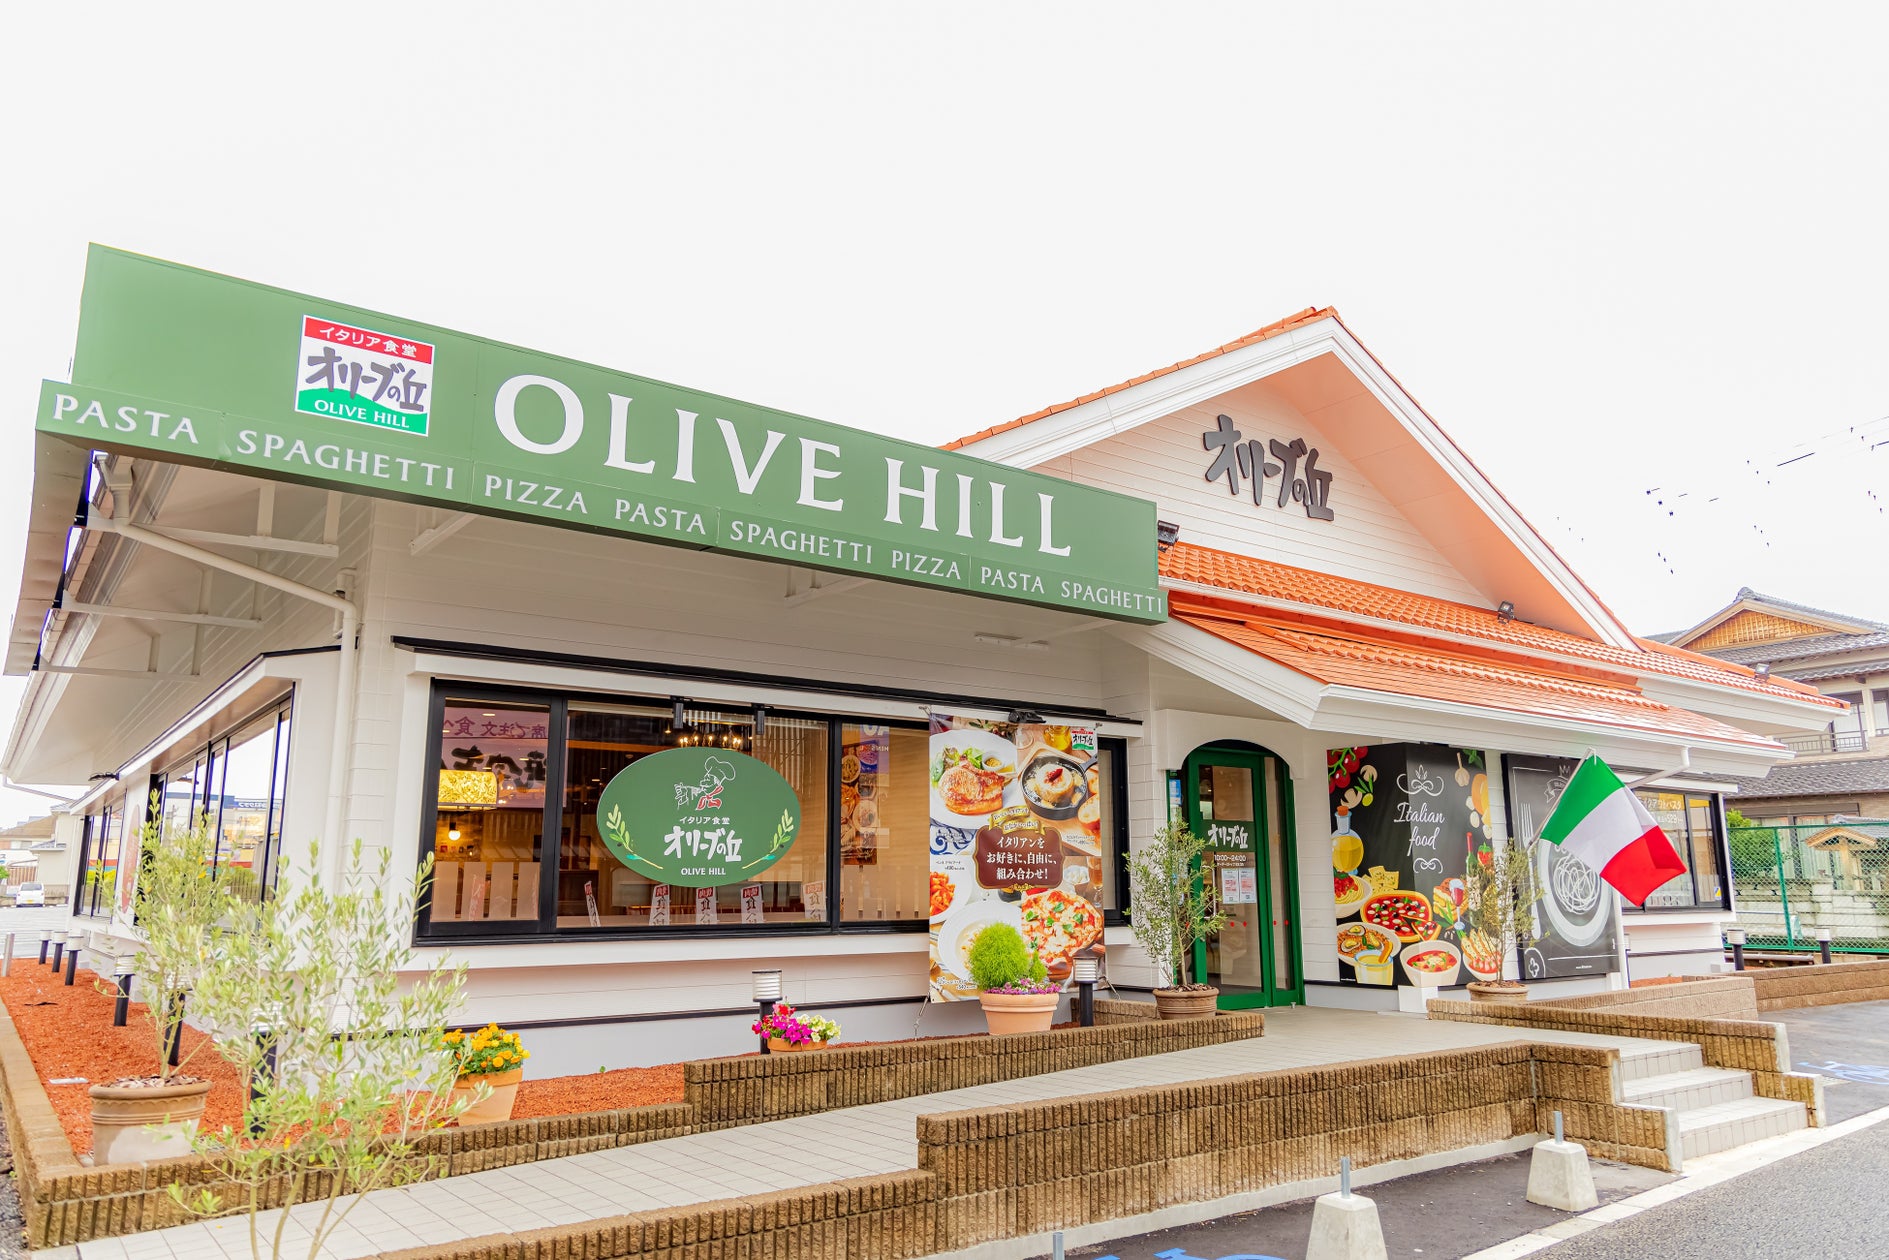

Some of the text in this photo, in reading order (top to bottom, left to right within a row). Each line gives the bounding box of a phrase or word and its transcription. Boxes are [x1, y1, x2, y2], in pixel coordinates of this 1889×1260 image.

[319, 326, 418, 358] イタリア食堂
[305, 346, 428, 412] オリーブの丘
[314, 399, 410, 428] OLIVE HILL
[494, 374, 1072, 557] OLIVE HILL
[1203, 414, 1335, 522] オリーブの丘
[52, 393, 1164, 614] PASTA SPAGHETTI PIZZA PASTA SPAGHETTI PIZZA PASTA SPAGHETTI
[680, 816, 730, 825] イタリア食堂
[1394, 802, 1445, 823] Italian
[664, 825, 743, 862] オリーブの丘
[997, 836, 1045, 849] イタリアンを
[1207, 823, 1249, 849] オリーブの丘
[1406, 826, 1440, 856] food
[681, 867, 727, 876] OLIVE HILL
[986, 852, 1057, 865] お好きに、自由に、
[996, 867, 1048, 880] 組み合わせ!
